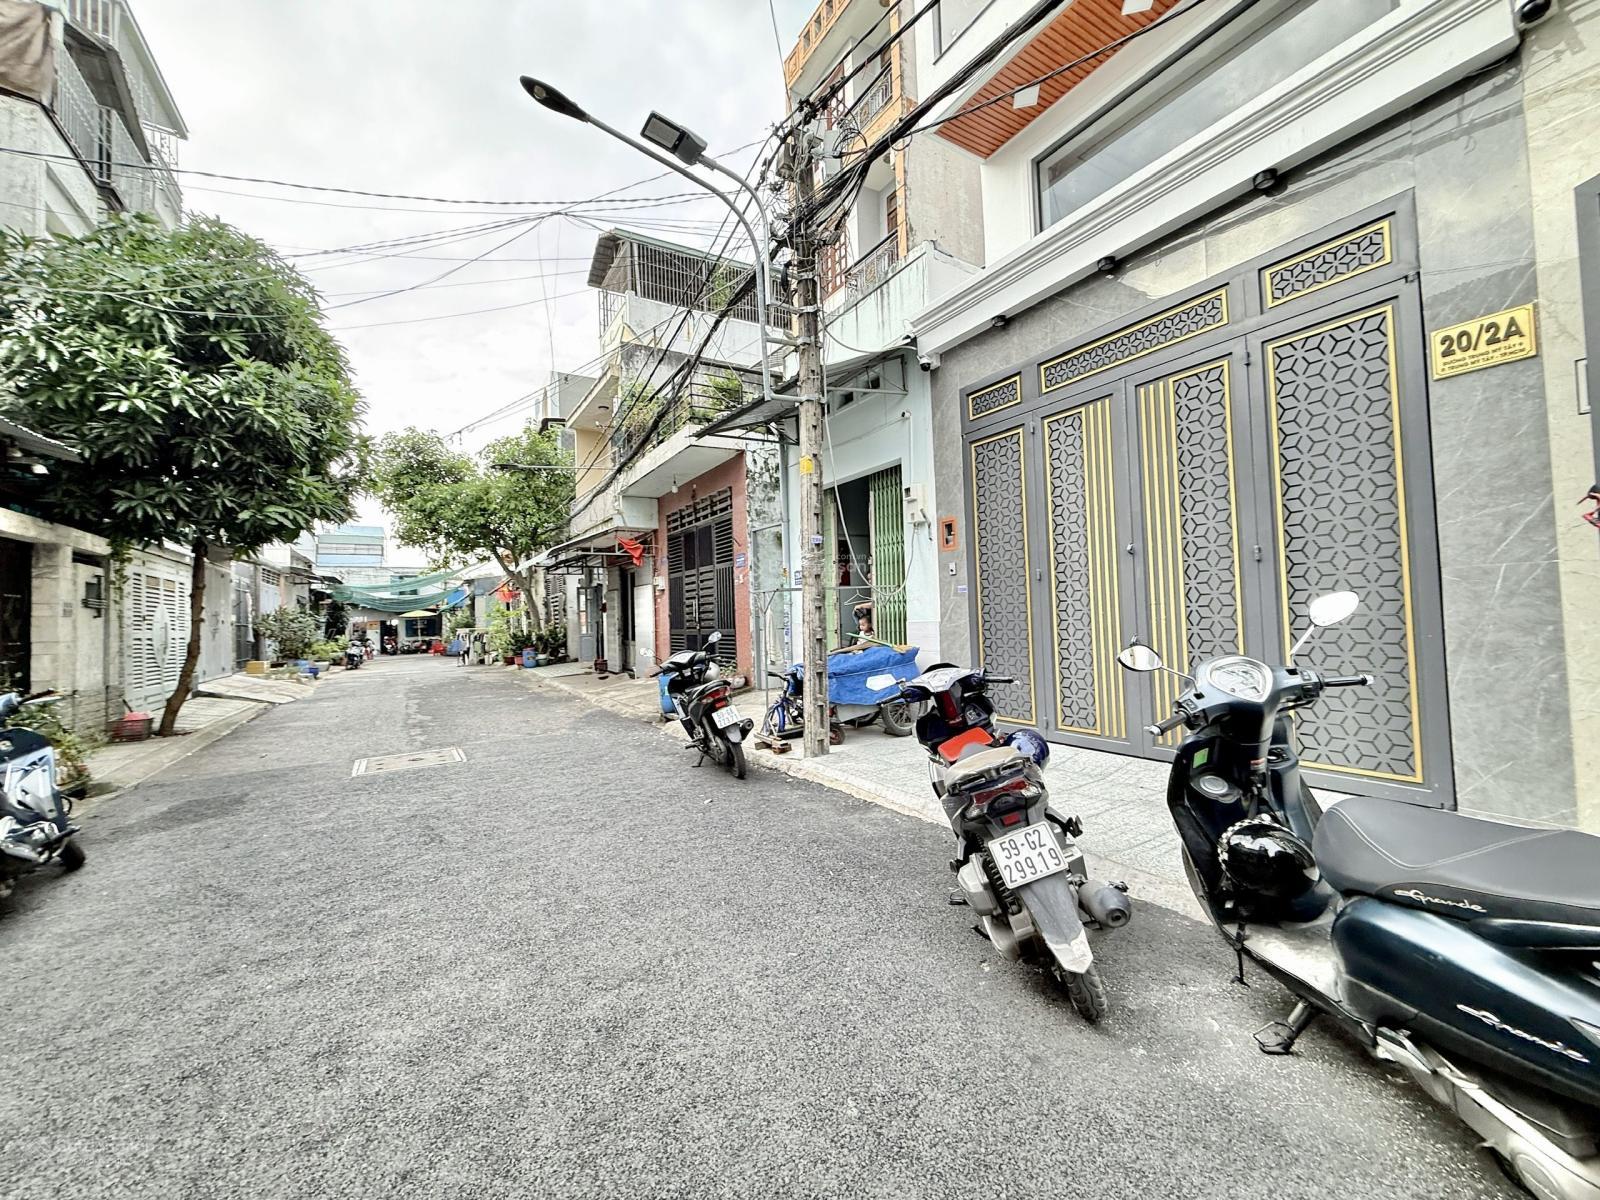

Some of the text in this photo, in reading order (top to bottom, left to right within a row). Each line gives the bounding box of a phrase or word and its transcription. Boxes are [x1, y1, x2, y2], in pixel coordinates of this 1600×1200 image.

[1440, 316, 1526, 358] 20/2A
[999, 829, 1046, 860] 59-G2
[1004, 847, 1062, 884] 299.19
[1393, 889, 1488, 913] Grande
